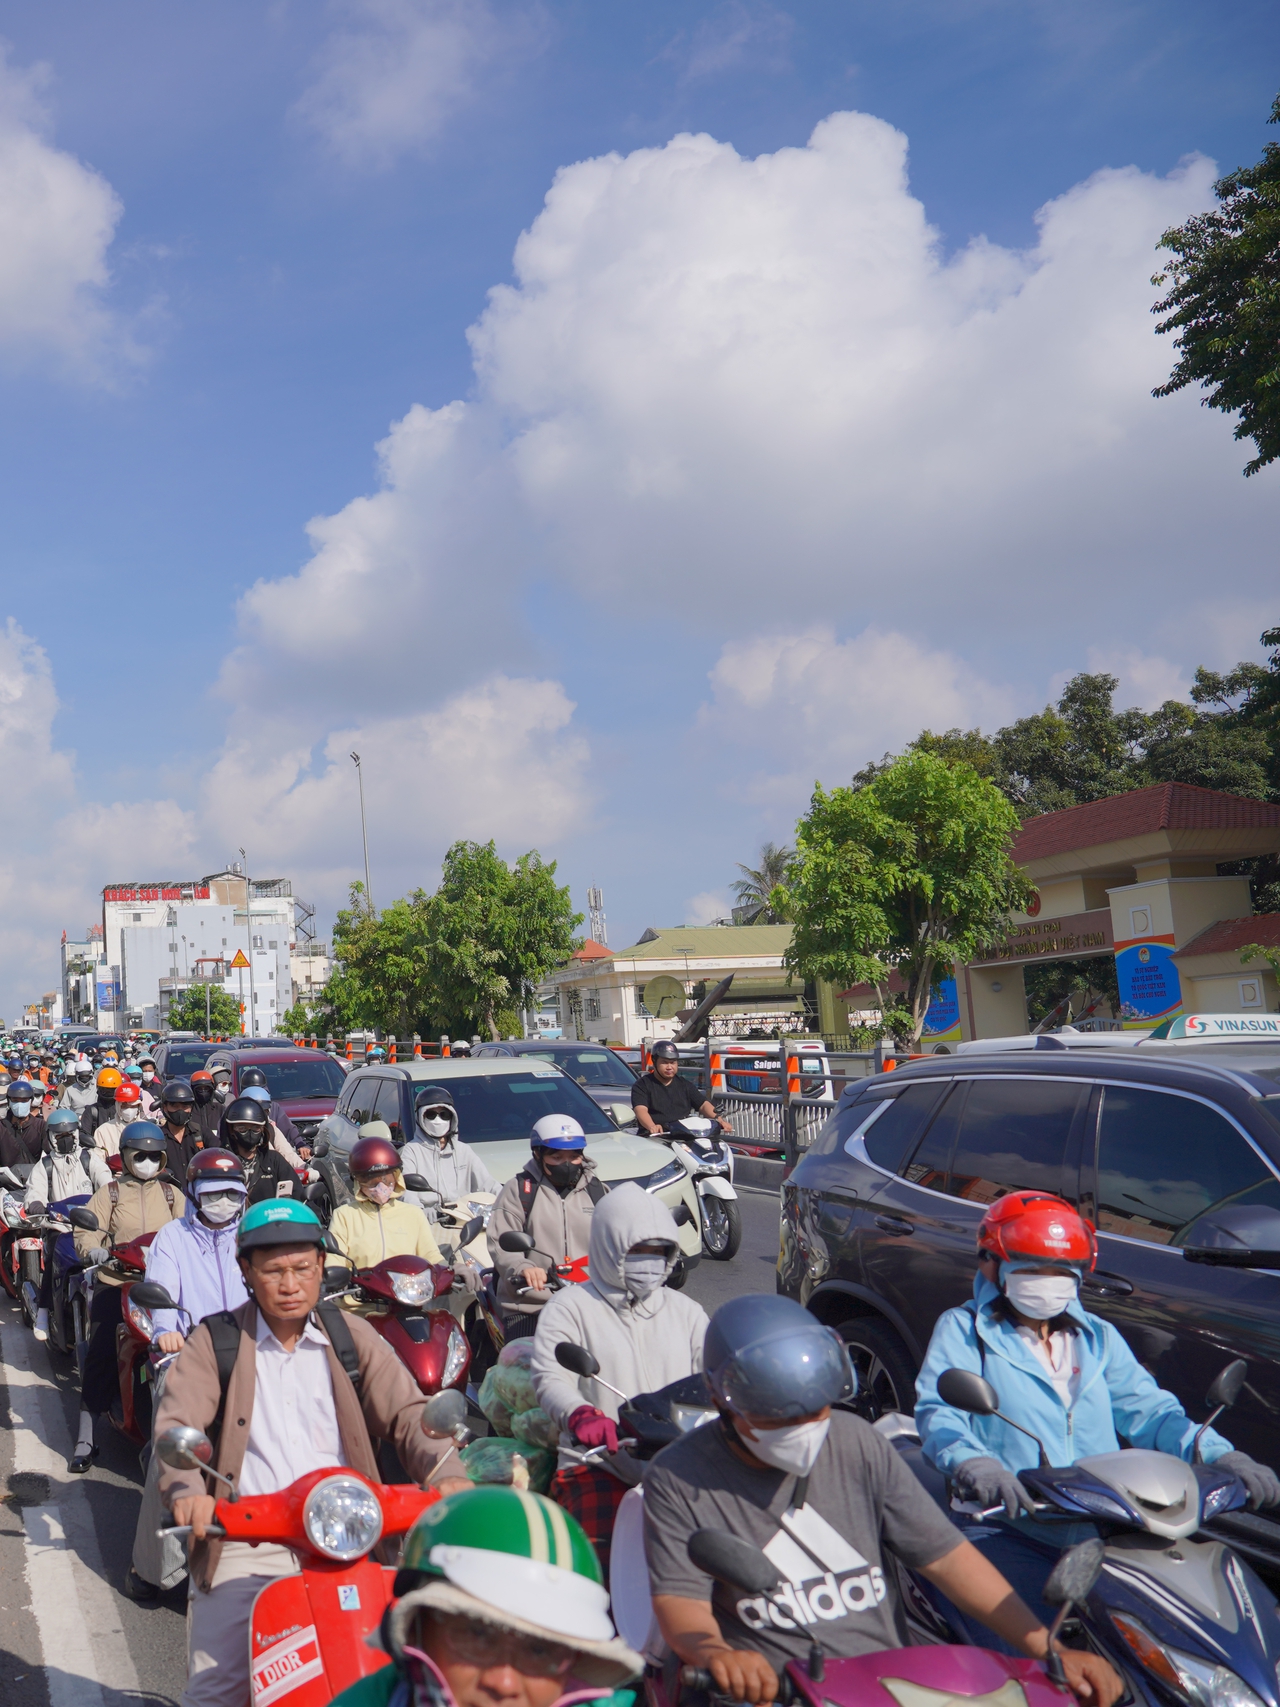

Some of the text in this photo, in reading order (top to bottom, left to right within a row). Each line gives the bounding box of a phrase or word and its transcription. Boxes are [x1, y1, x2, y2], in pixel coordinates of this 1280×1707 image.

[104, 886, 136, 902] KHÁCH
[139, 888, 159, 903] SẠN
[1082, 931, 1106, 948] NAM
[1213, 1020, 1278, 1032] VINASUN
[753, 1060, 781, 1070] Saigon
[736, 1566, 887, 1630] adidas
[263, 1651, 304, 1686] DIOR
